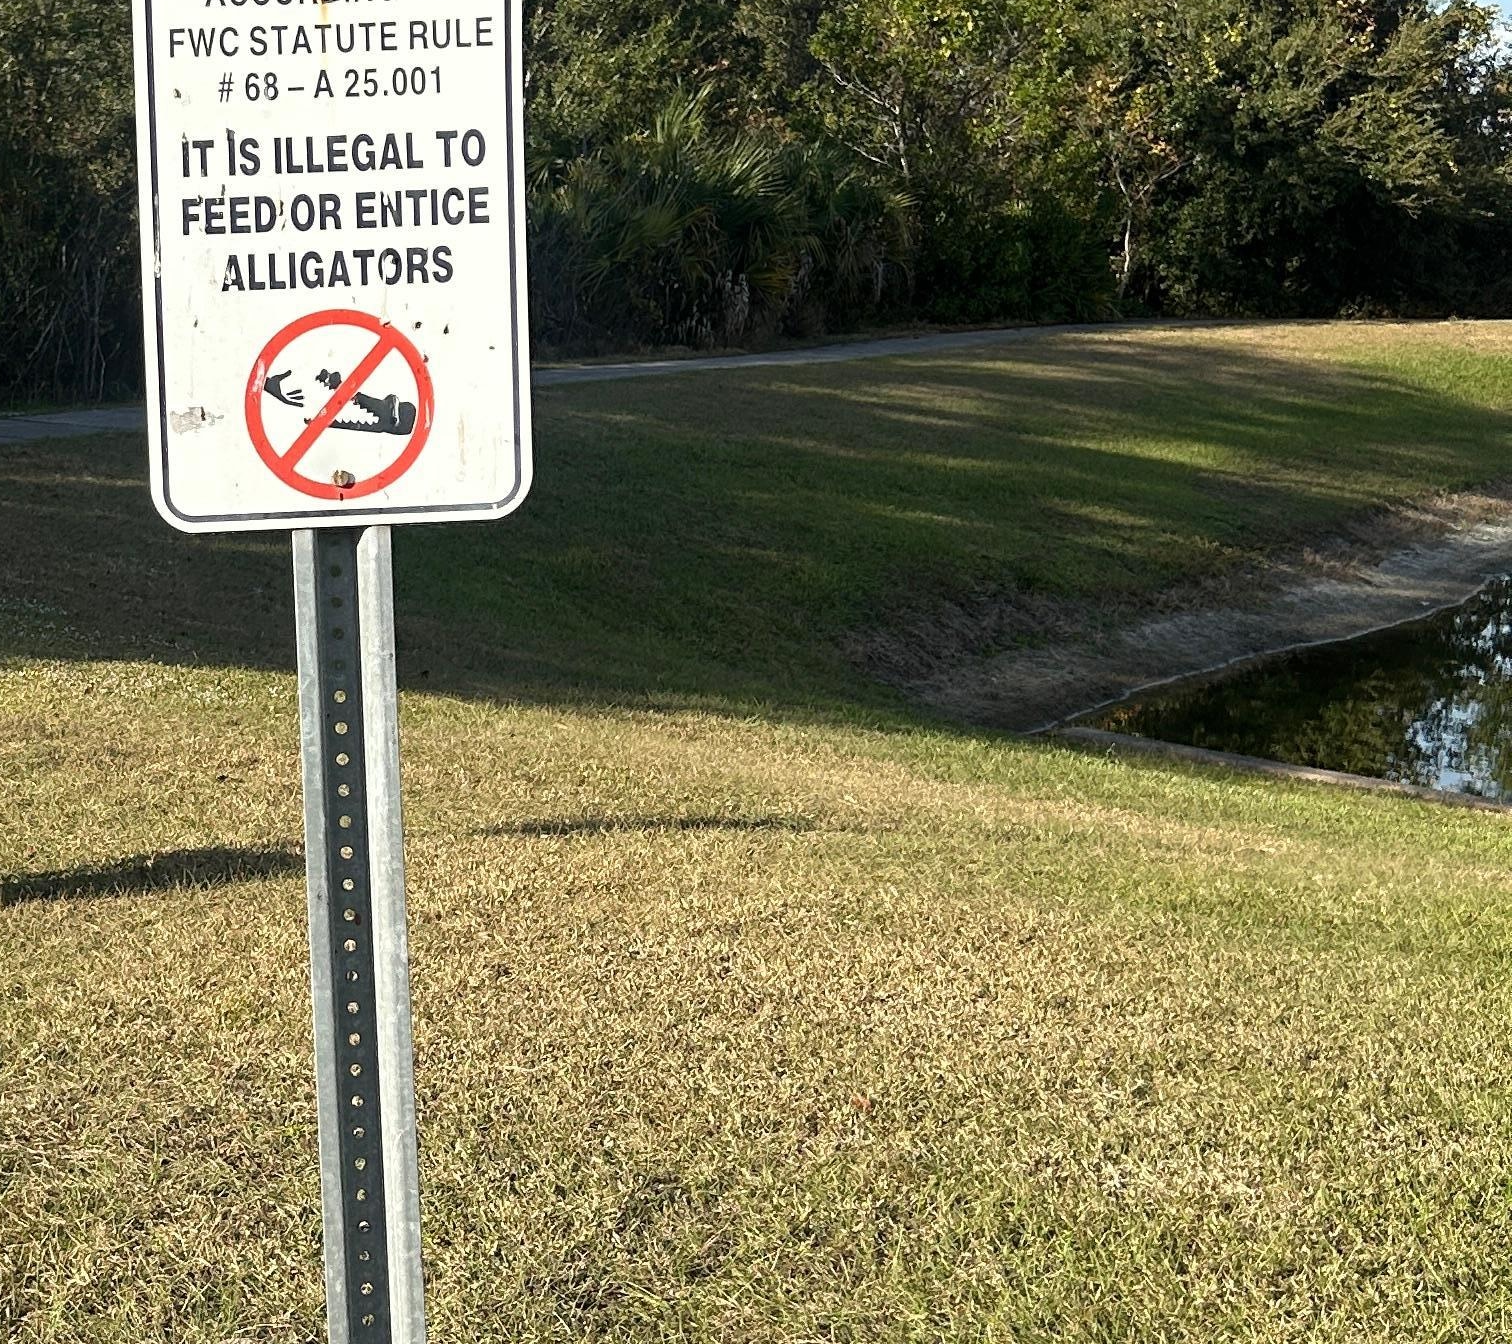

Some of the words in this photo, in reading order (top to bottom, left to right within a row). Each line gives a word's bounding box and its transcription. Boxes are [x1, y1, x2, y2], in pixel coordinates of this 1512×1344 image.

[169, 27, 239, 57] FWC
[249, 21, 398, 55] STATUTE
[409, 17, 493, 50] RULE
[218, 72, 235, 103] #
[244, 72, 279, 101] 68
[314, 69, 334, 99] A
[344, 66, 442, 98] 25.001
[181, 137, 215, 178] IT
[227, 132, 261, 177] IS
[274, 132, 423, 175] ILLEGAL
[436, 128, 486, 168] TO
[182, 195, 277, 235] FEED
[291, 192, 342, 232] OR
[355, 187, 490, 229] ENTICE
[221, 245, 454, 292] ALLIGATORS
